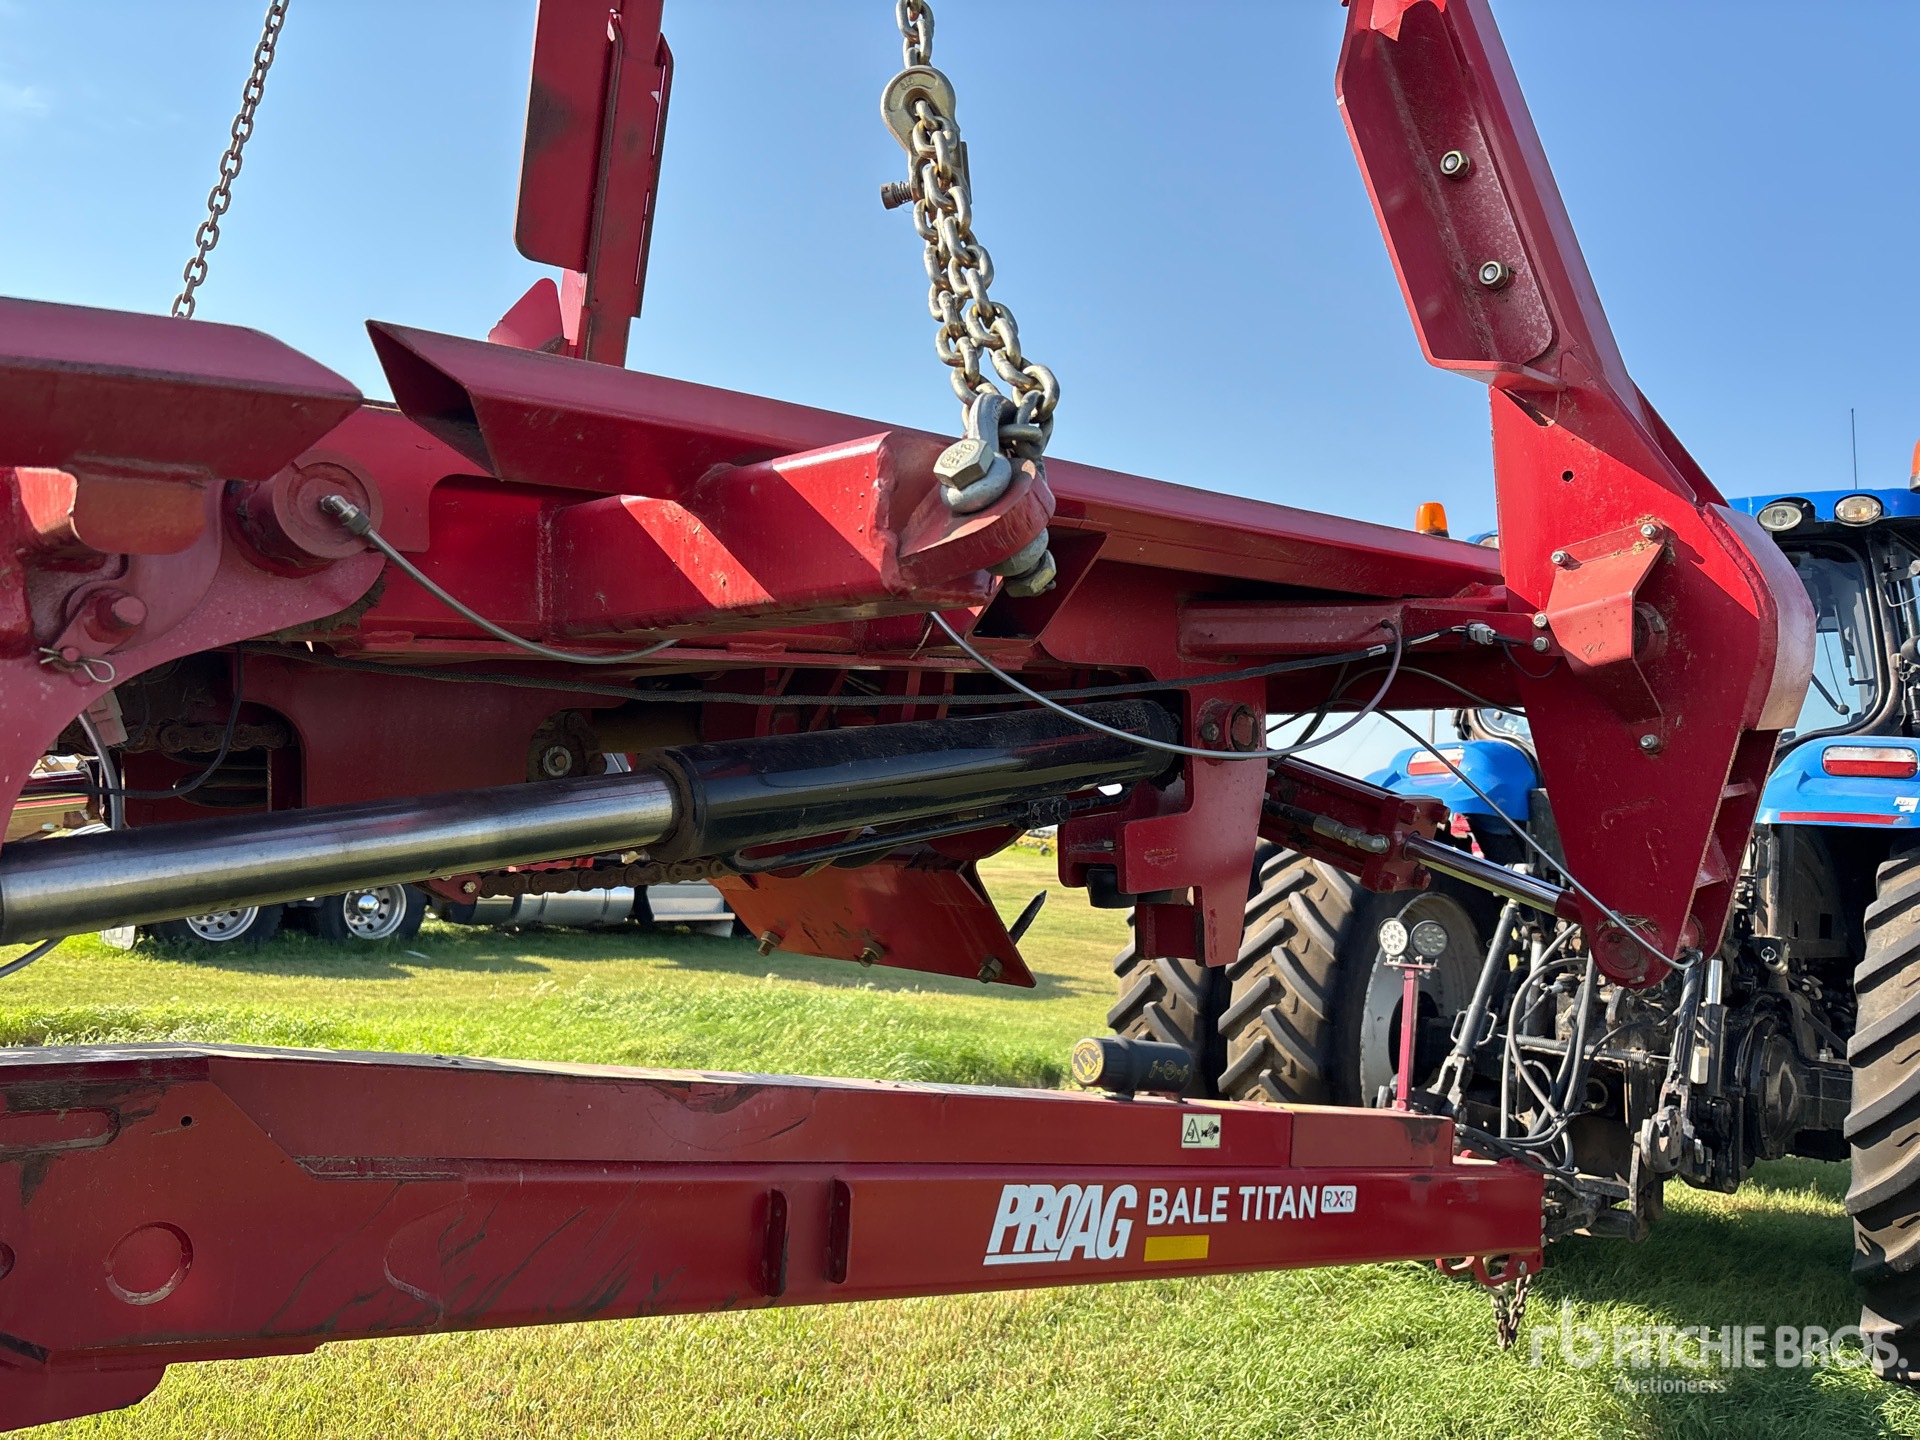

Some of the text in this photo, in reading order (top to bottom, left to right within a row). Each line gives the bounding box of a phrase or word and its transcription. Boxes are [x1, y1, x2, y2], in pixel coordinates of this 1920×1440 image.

[983, 1184, 1354, 1264] PROAG BALE TITAN RXR
